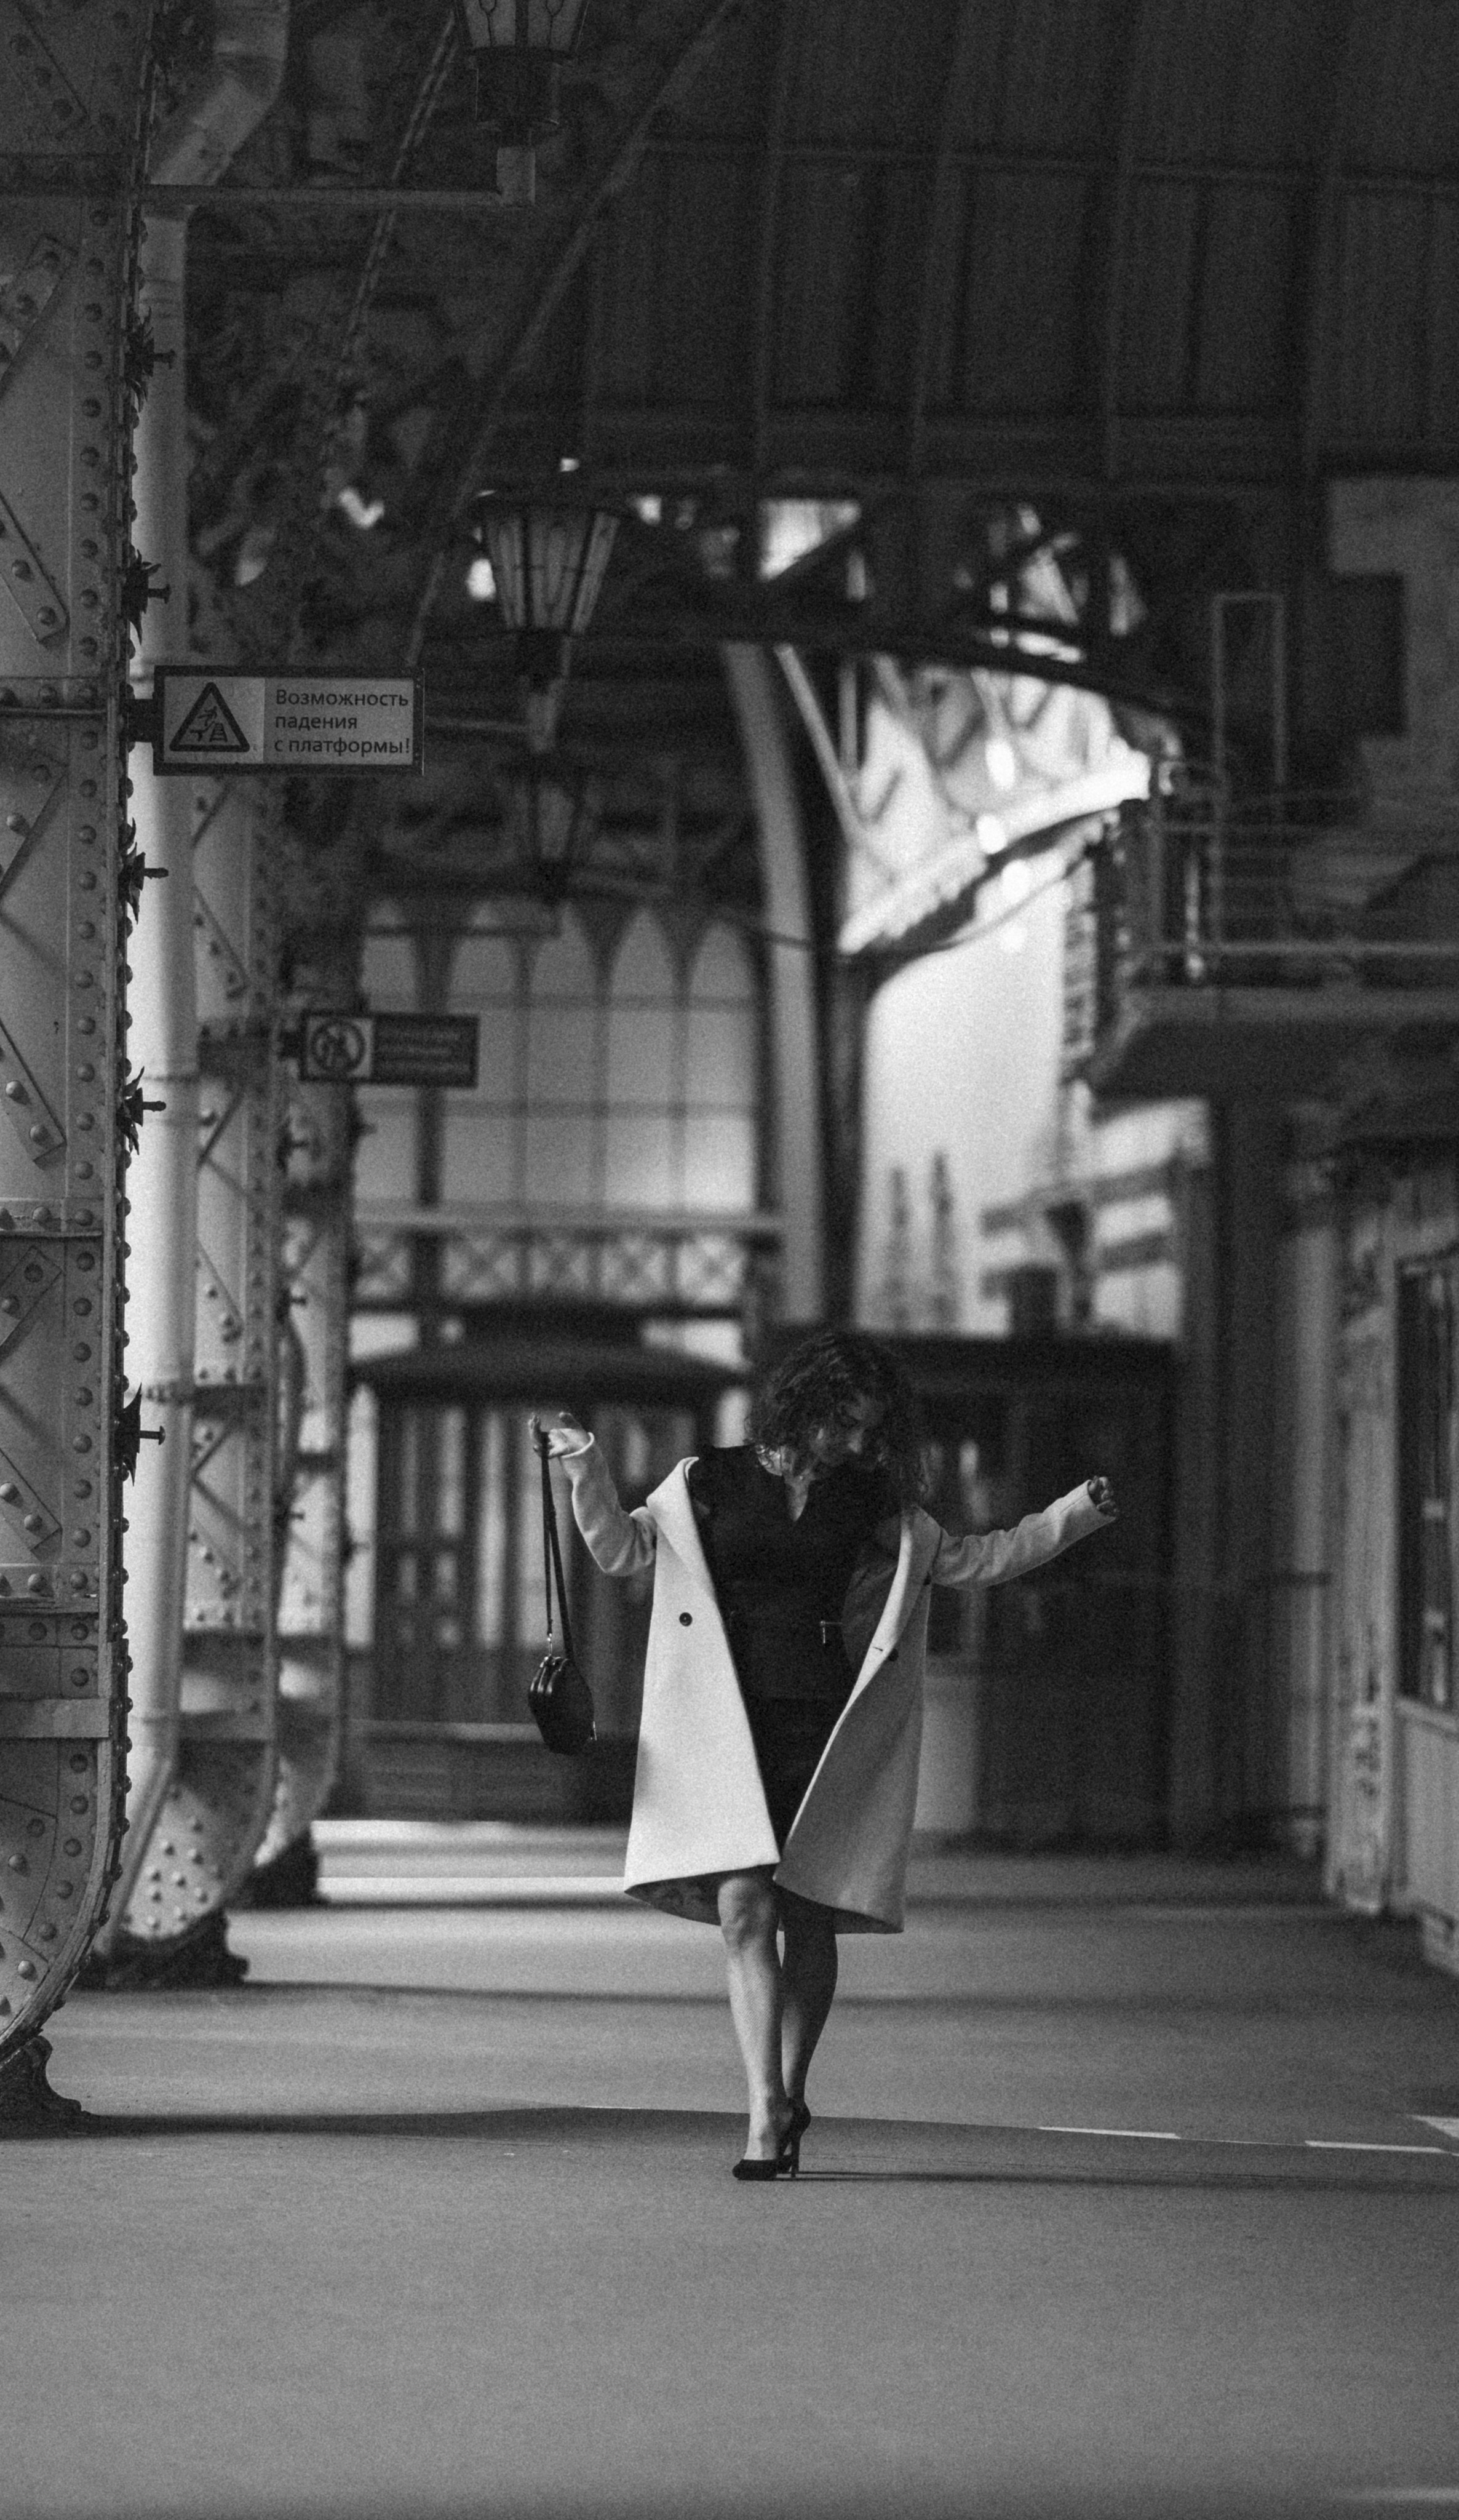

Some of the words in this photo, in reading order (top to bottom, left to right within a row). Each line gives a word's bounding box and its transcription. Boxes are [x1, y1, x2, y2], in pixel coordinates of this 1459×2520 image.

[276, 689, 409, 706] Возможность
[275, 715, 357, 730] падения
[274, 739, 284, 752] с
[288, 738, 410, 757] платформы!
